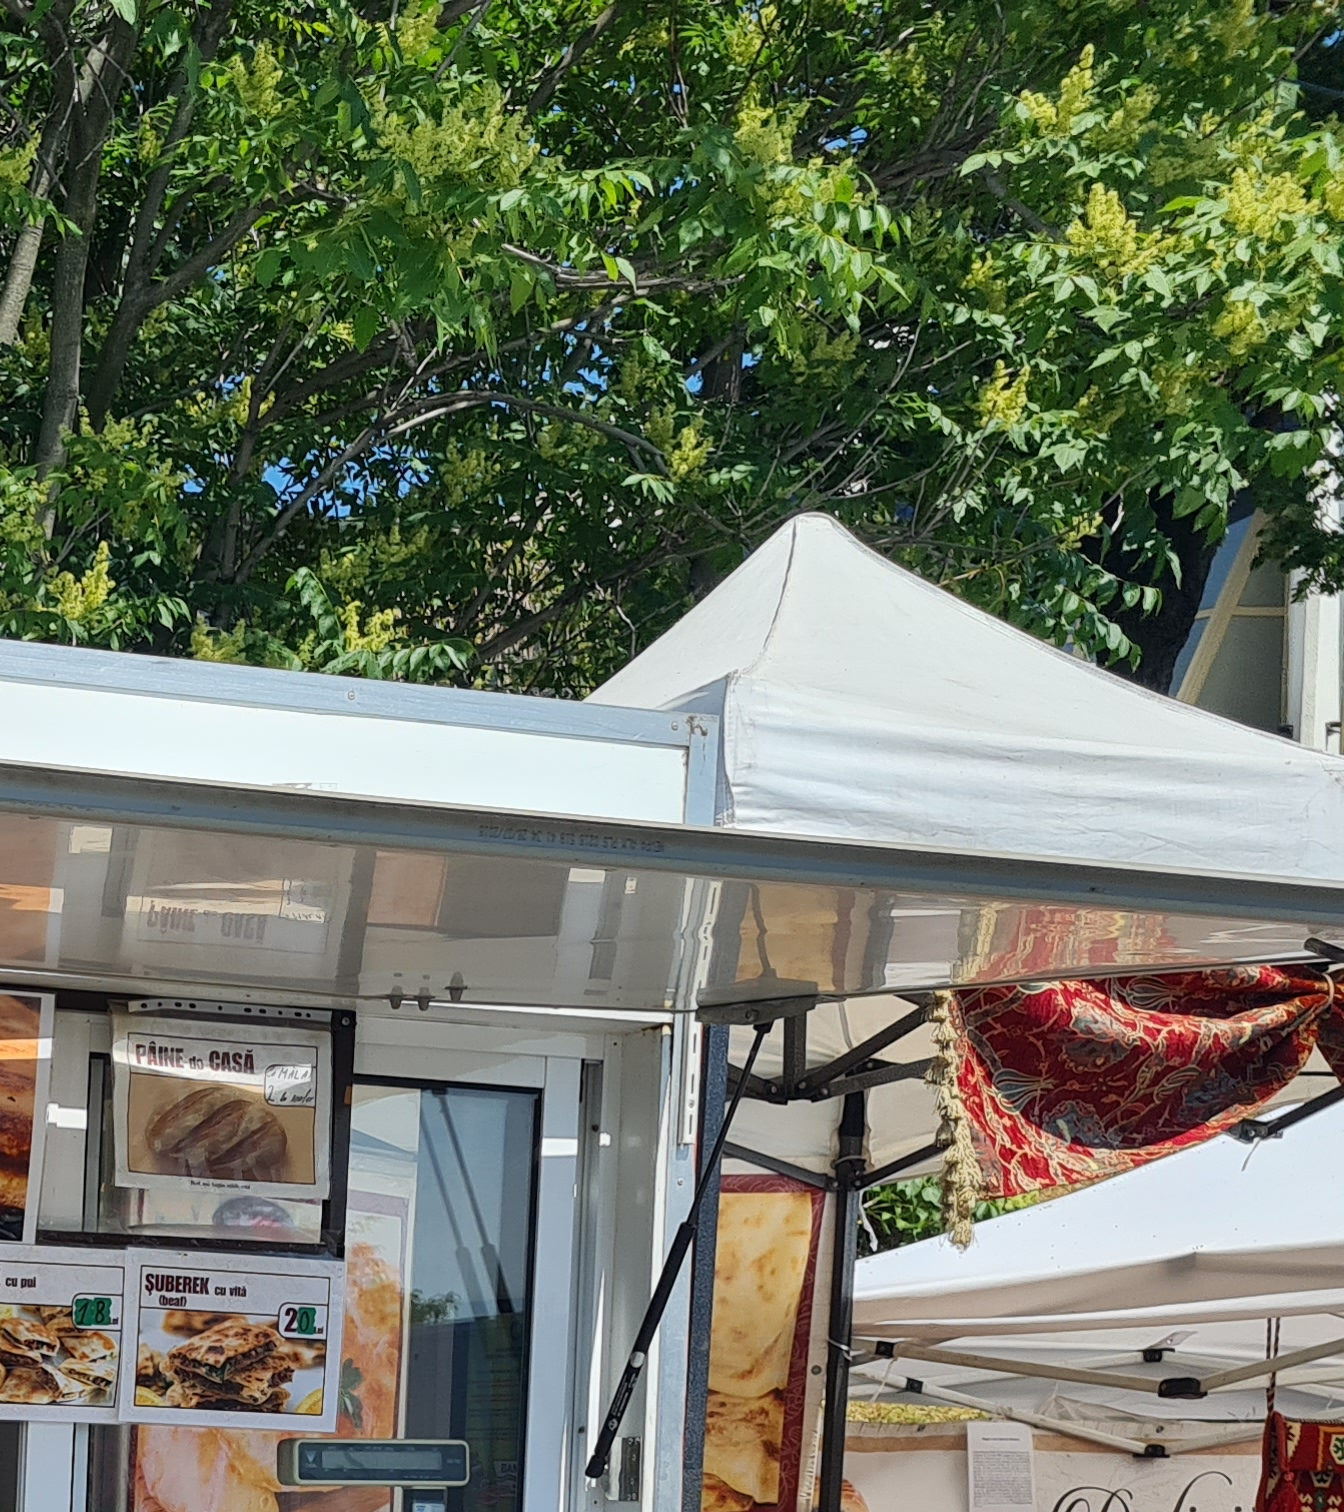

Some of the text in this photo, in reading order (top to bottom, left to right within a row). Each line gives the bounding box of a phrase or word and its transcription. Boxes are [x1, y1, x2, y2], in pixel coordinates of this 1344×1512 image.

[6, 1278, 17, 1287] cu
[215, 1288, 226, 1296] cu
[78, 1301, 105, 1323] 18
